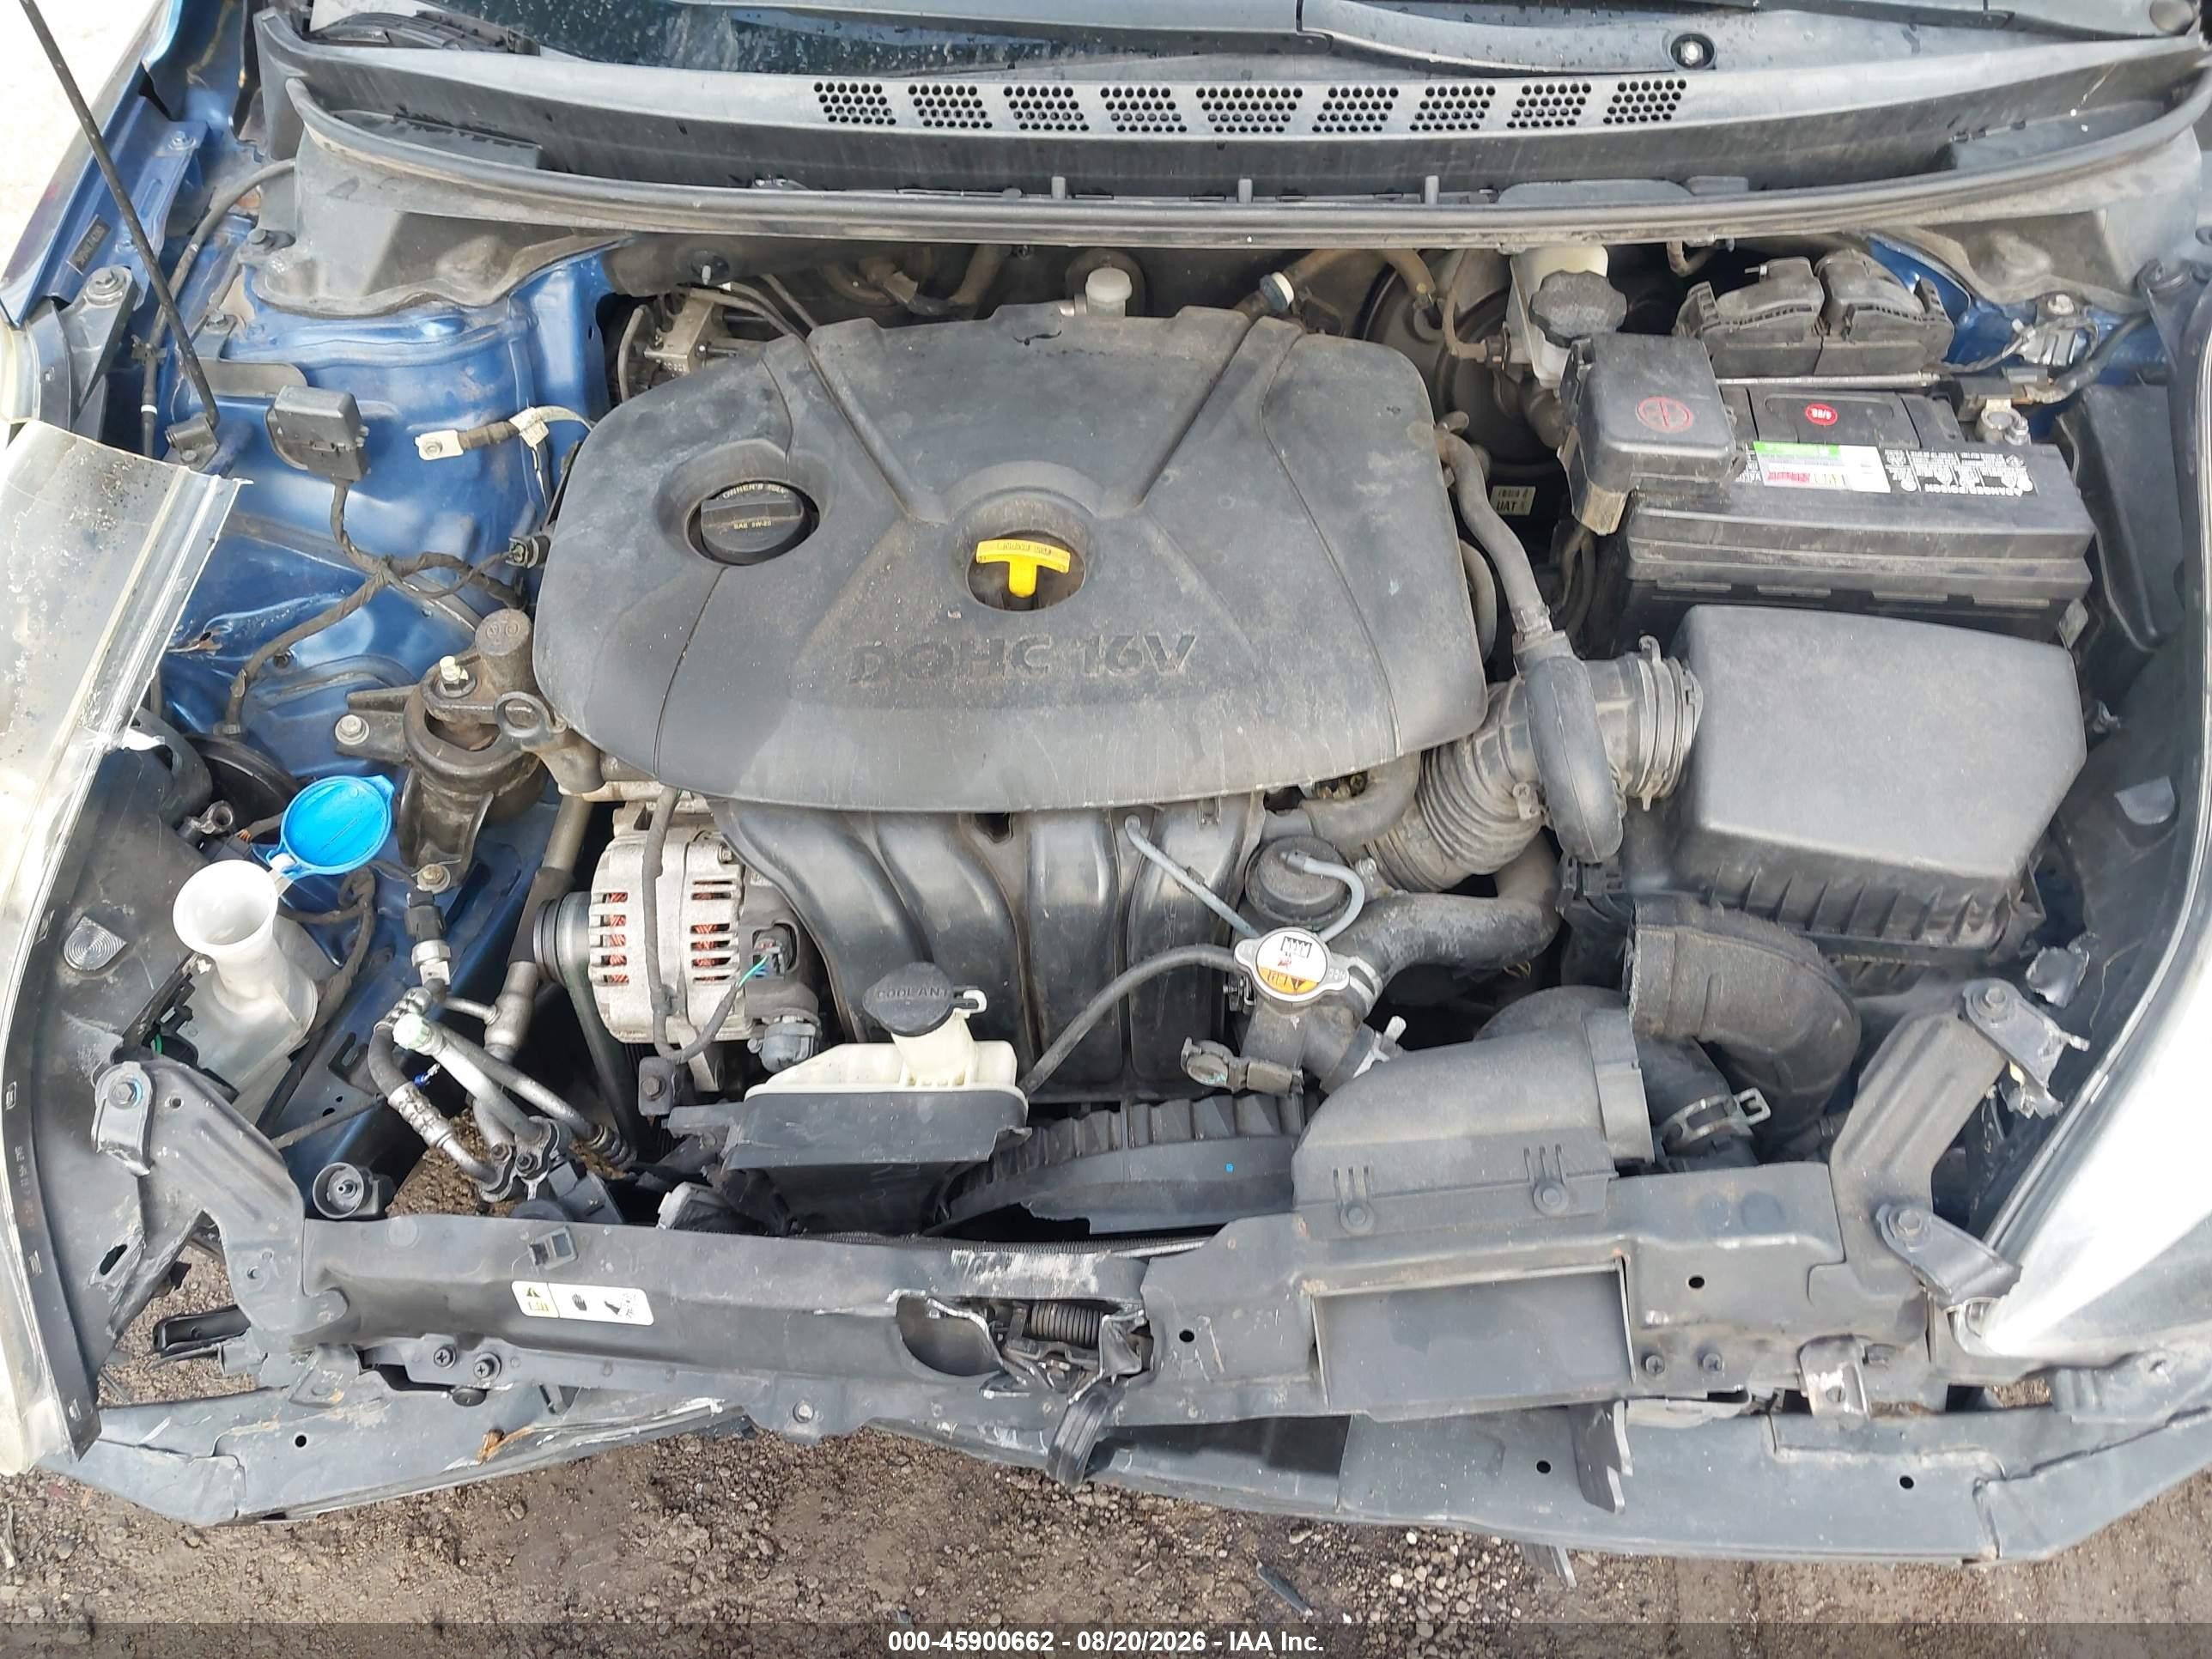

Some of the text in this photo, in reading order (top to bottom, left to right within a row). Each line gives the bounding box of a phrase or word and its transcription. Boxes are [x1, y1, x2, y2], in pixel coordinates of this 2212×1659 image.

[848, 632, 1197, 683] DOHC 16V
[878, 985, 949, 1000] COOLANT
